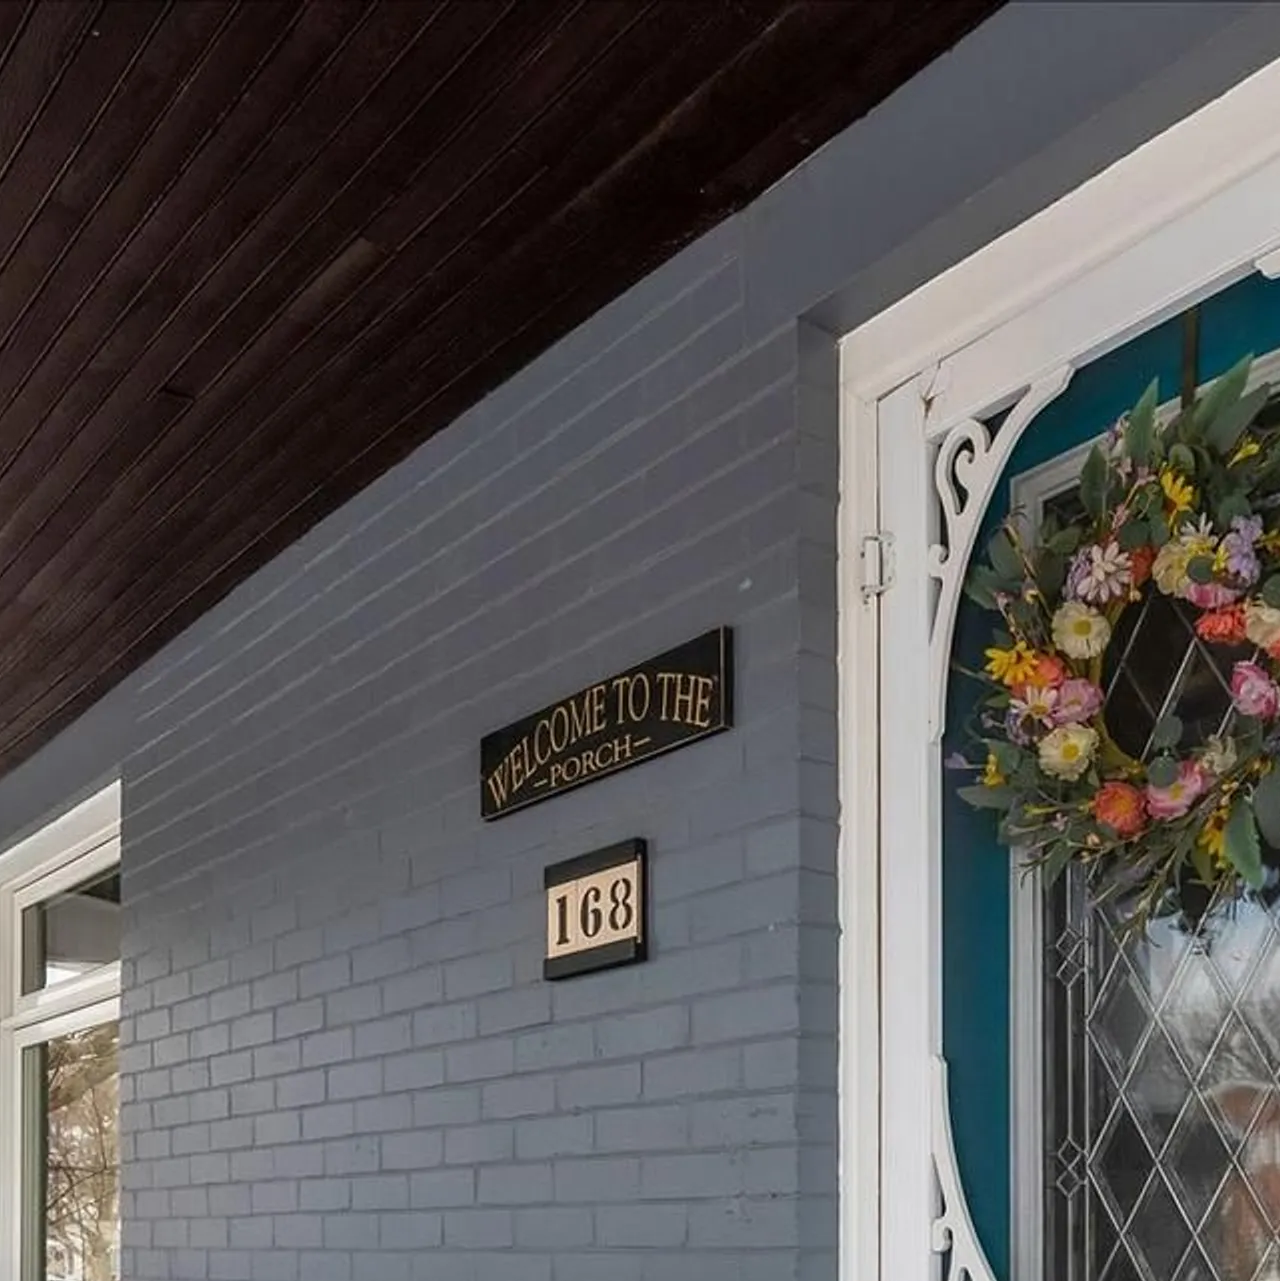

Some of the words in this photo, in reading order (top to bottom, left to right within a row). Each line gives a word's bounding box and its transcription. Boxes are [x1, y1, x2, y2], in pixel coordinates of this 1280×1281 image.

[487, 685, 606, 809] WELCOME
[613, 673, 650, 724] TO
[656, 672, 714, 728] THE
[555, 877, 632, 946] 168
